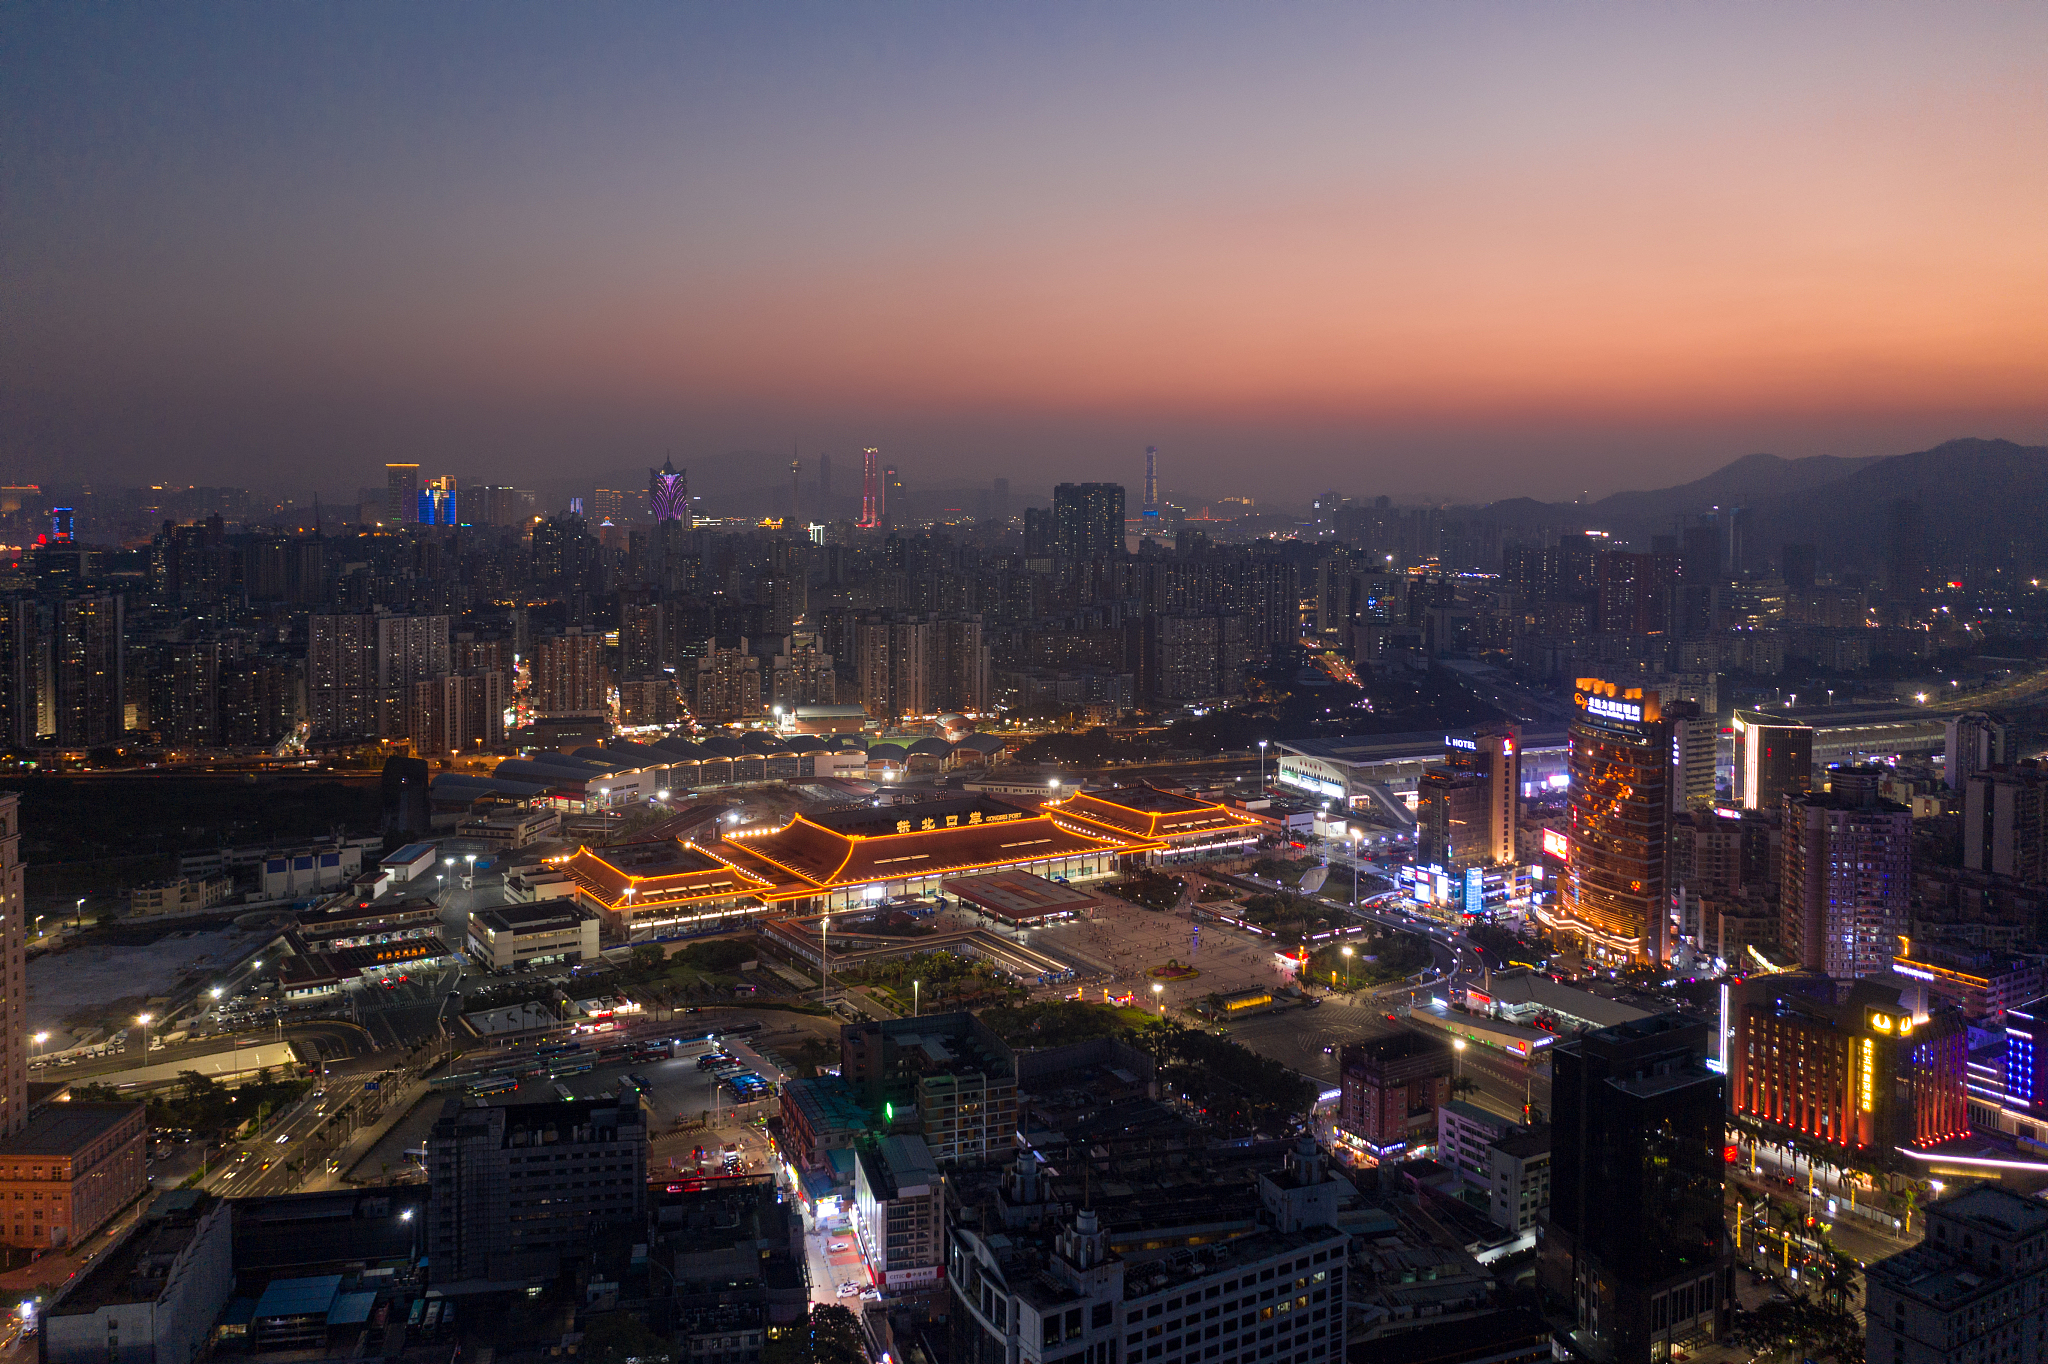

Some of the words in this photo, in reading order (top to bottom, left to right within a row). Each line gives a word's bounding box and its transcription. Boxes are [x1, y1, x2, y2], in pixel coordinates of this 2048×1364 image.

[1445, 735, 1452, 746] L
[1452, 738, 1477, 751] HOTEL
[896, 811, 983, 833] 拱北口岸
[985, 814, 1008, 822] GONGBEI
[1008, 812, 1022, 820] PORT
